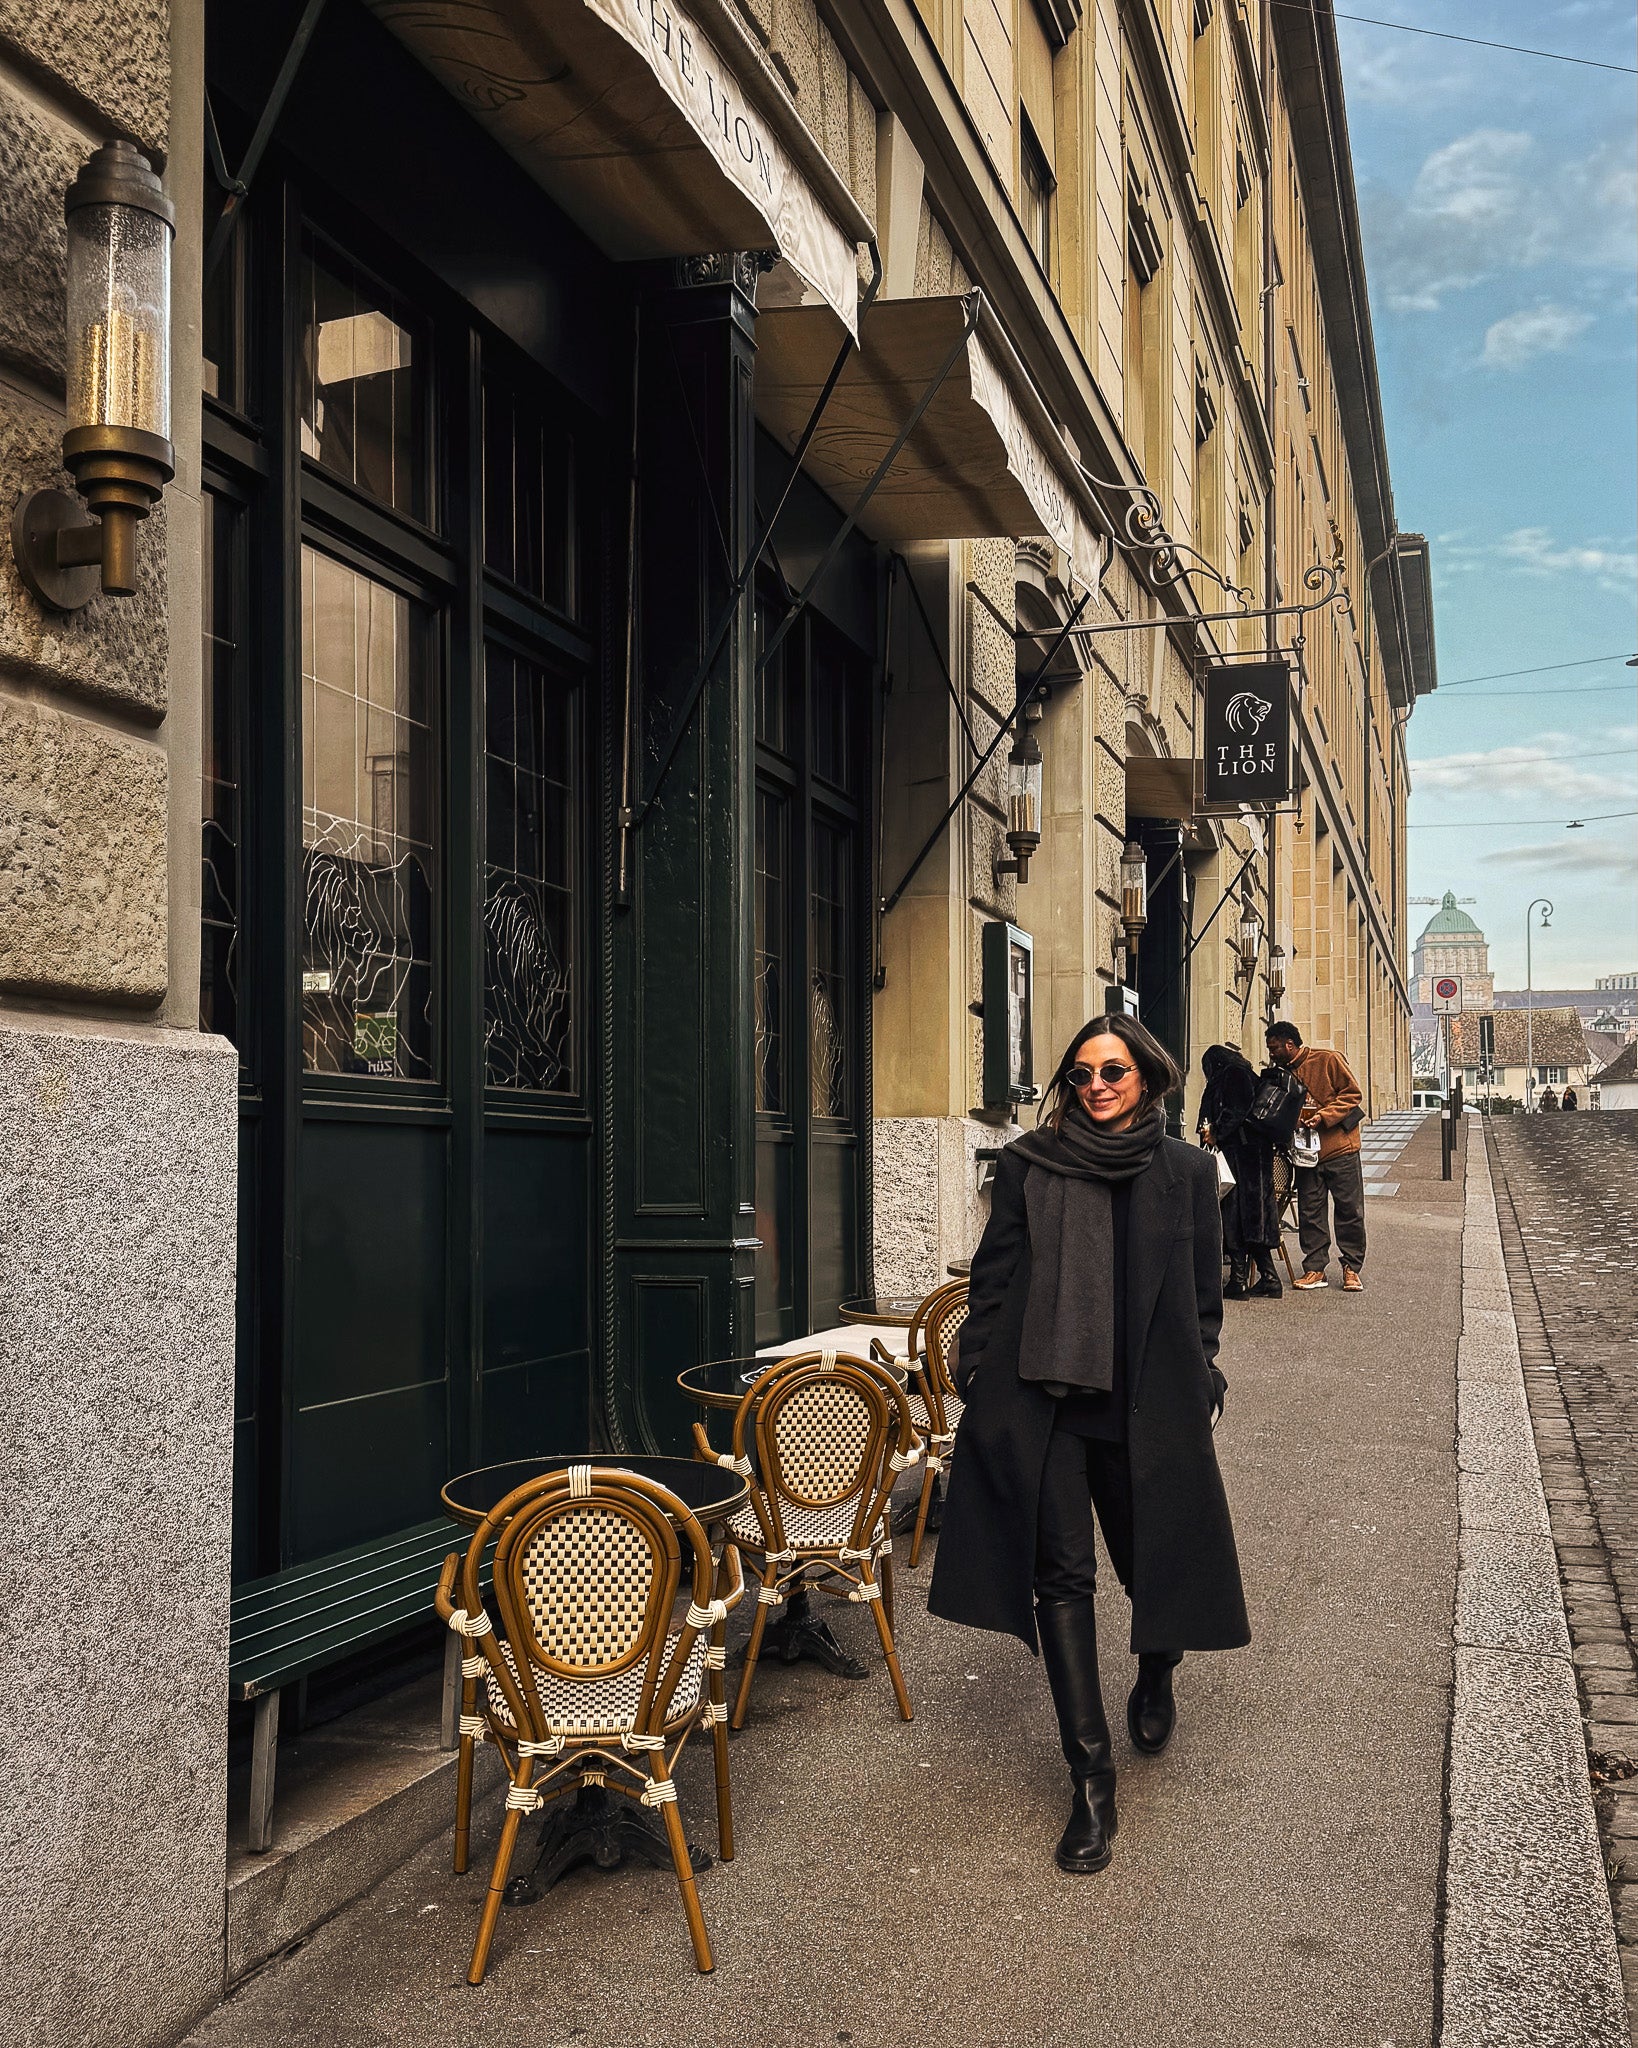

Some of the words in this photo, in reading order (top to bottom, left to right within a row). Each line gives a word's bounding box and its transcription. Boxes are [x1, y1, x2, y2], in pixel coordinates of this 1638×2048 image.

[636, 0, 694, 88] HE
[705, 71, 772, 195] LION
[1040, 474, 1068, 534] LION
[1218, 743, 1276, 760] THE
[1218, 759, 1275, 776] LION
